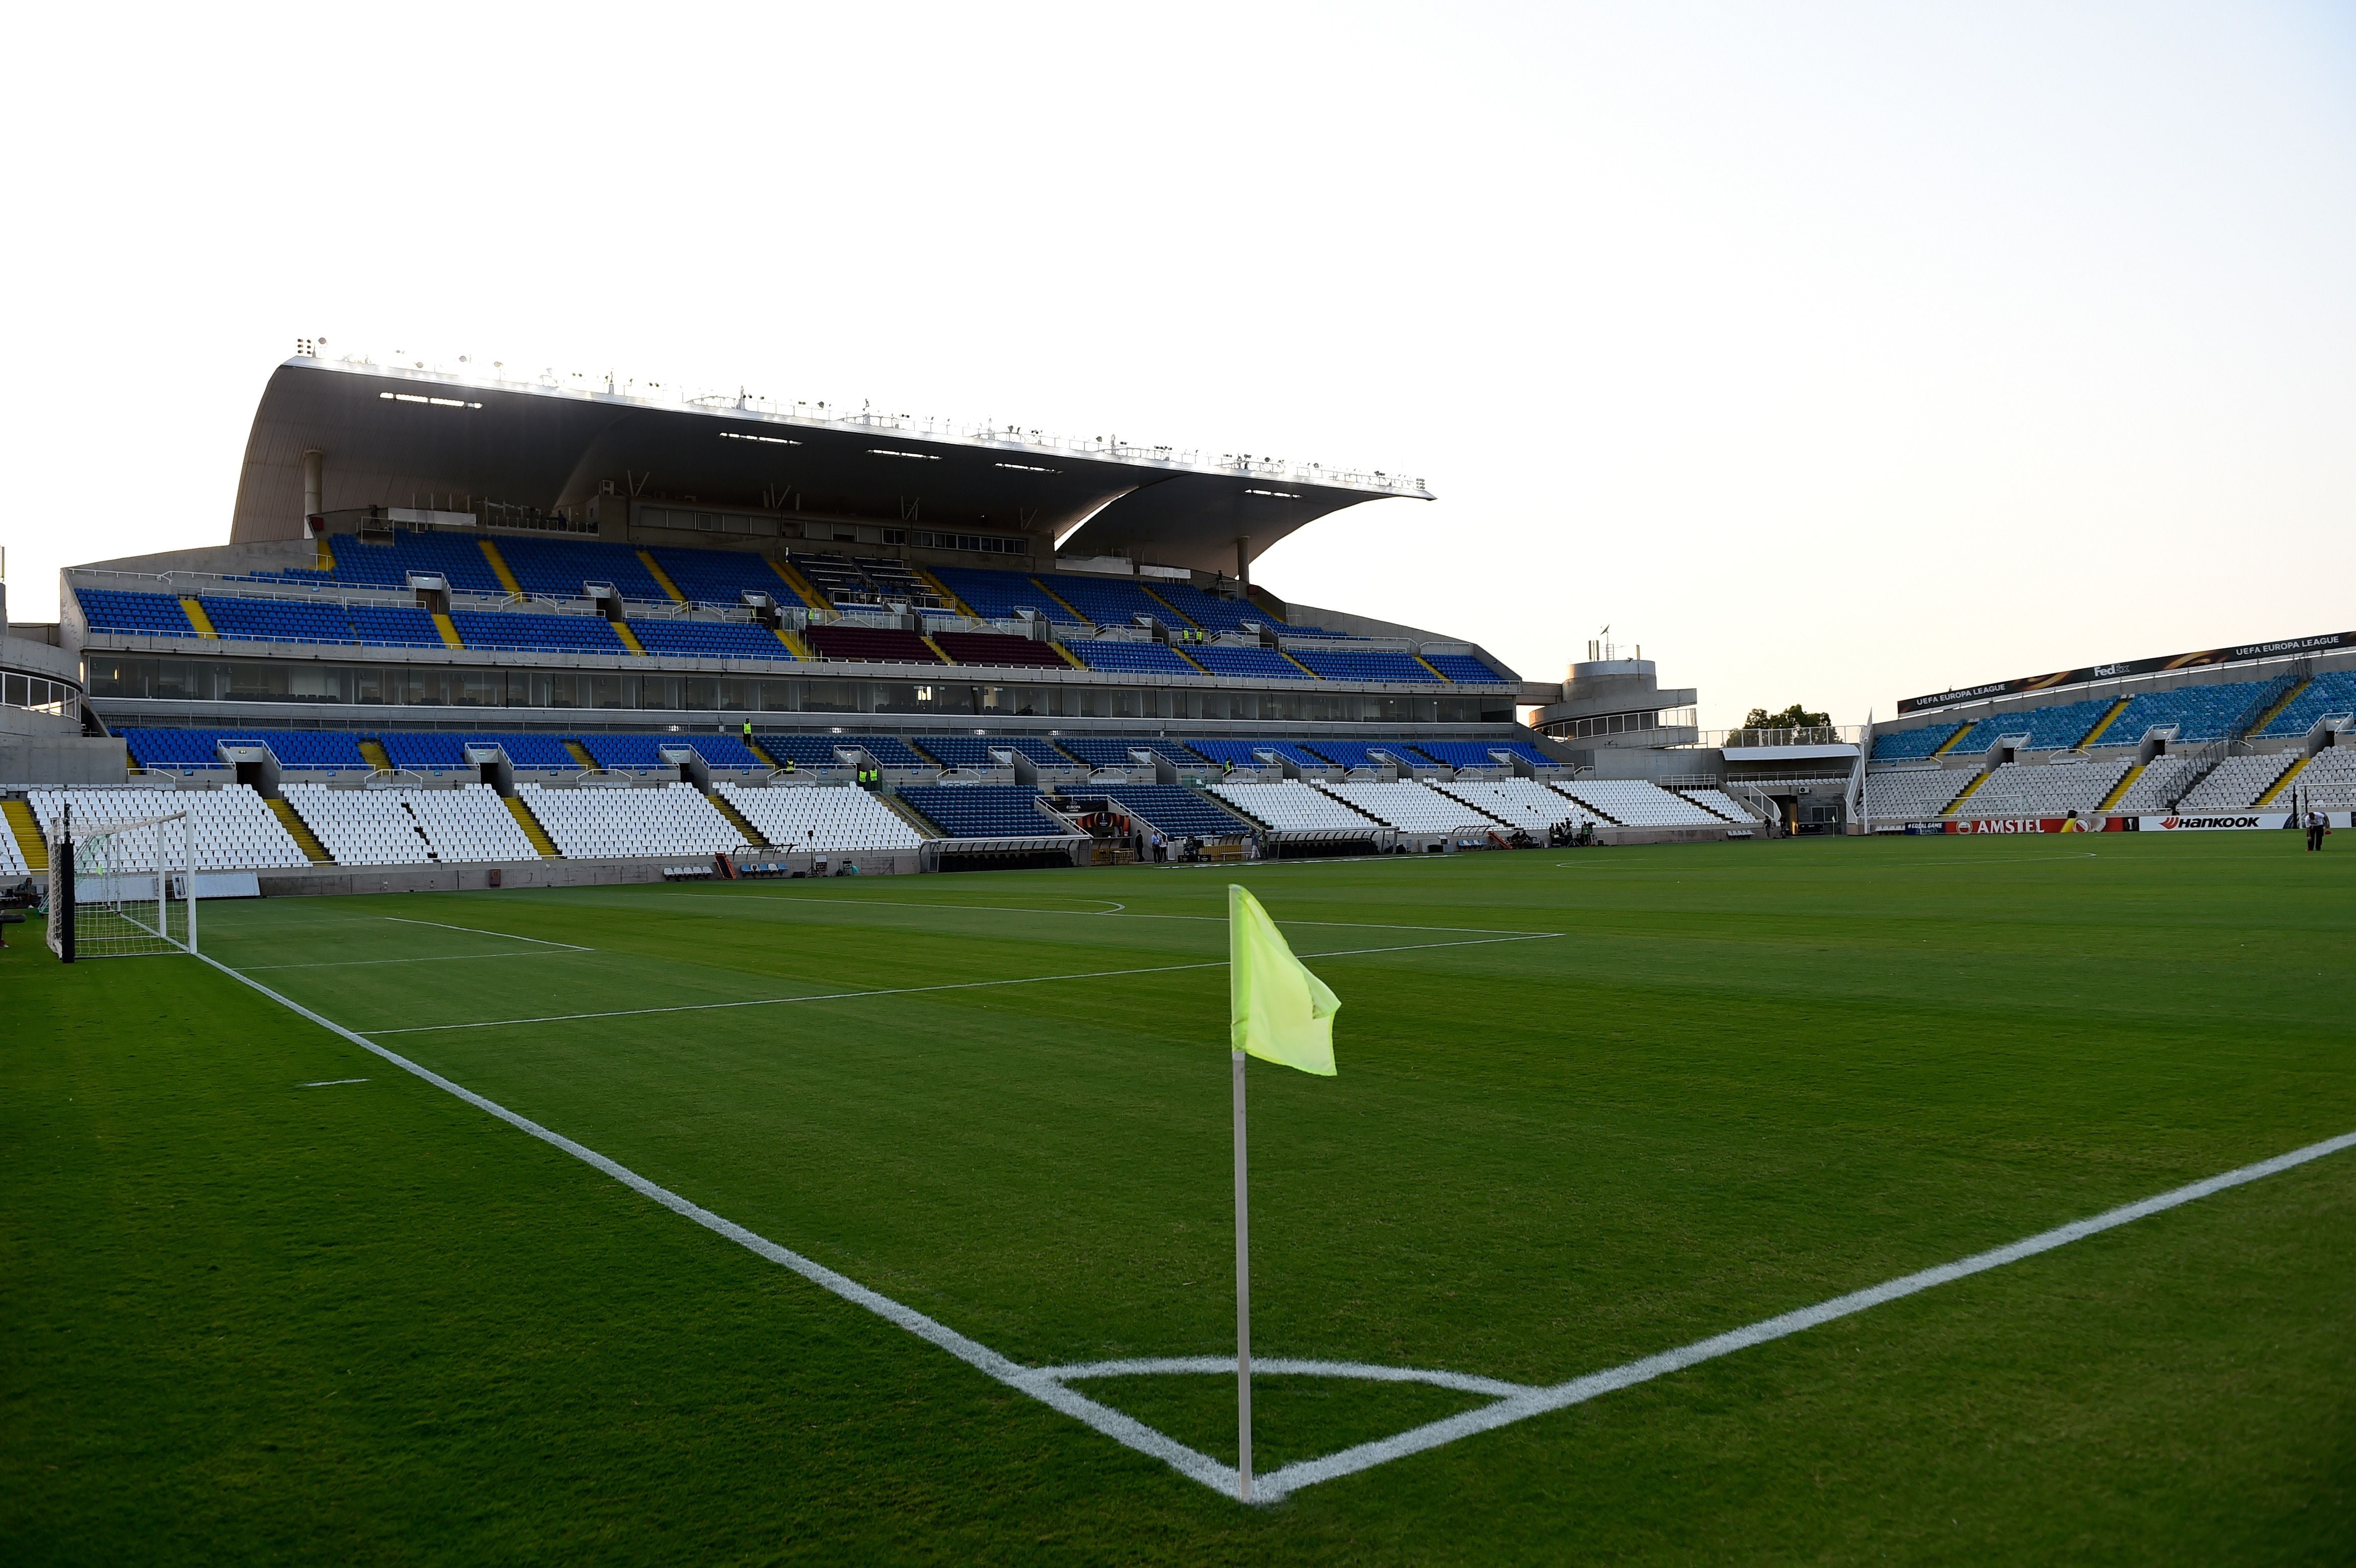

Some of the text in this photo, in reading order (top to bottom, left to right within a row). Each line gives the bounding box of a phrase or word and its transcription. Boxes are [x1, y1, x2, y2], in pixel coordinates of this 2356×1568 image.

[2236, 636, 2339, 655] UEFA EUROPA LEAGUE
[2094, 663, 2130, 677] FedEx
[1917, 684, 2006, 705] UEFA EUROPA LEAGUE
[1977, 819, 2045, 834] AMSTEL
